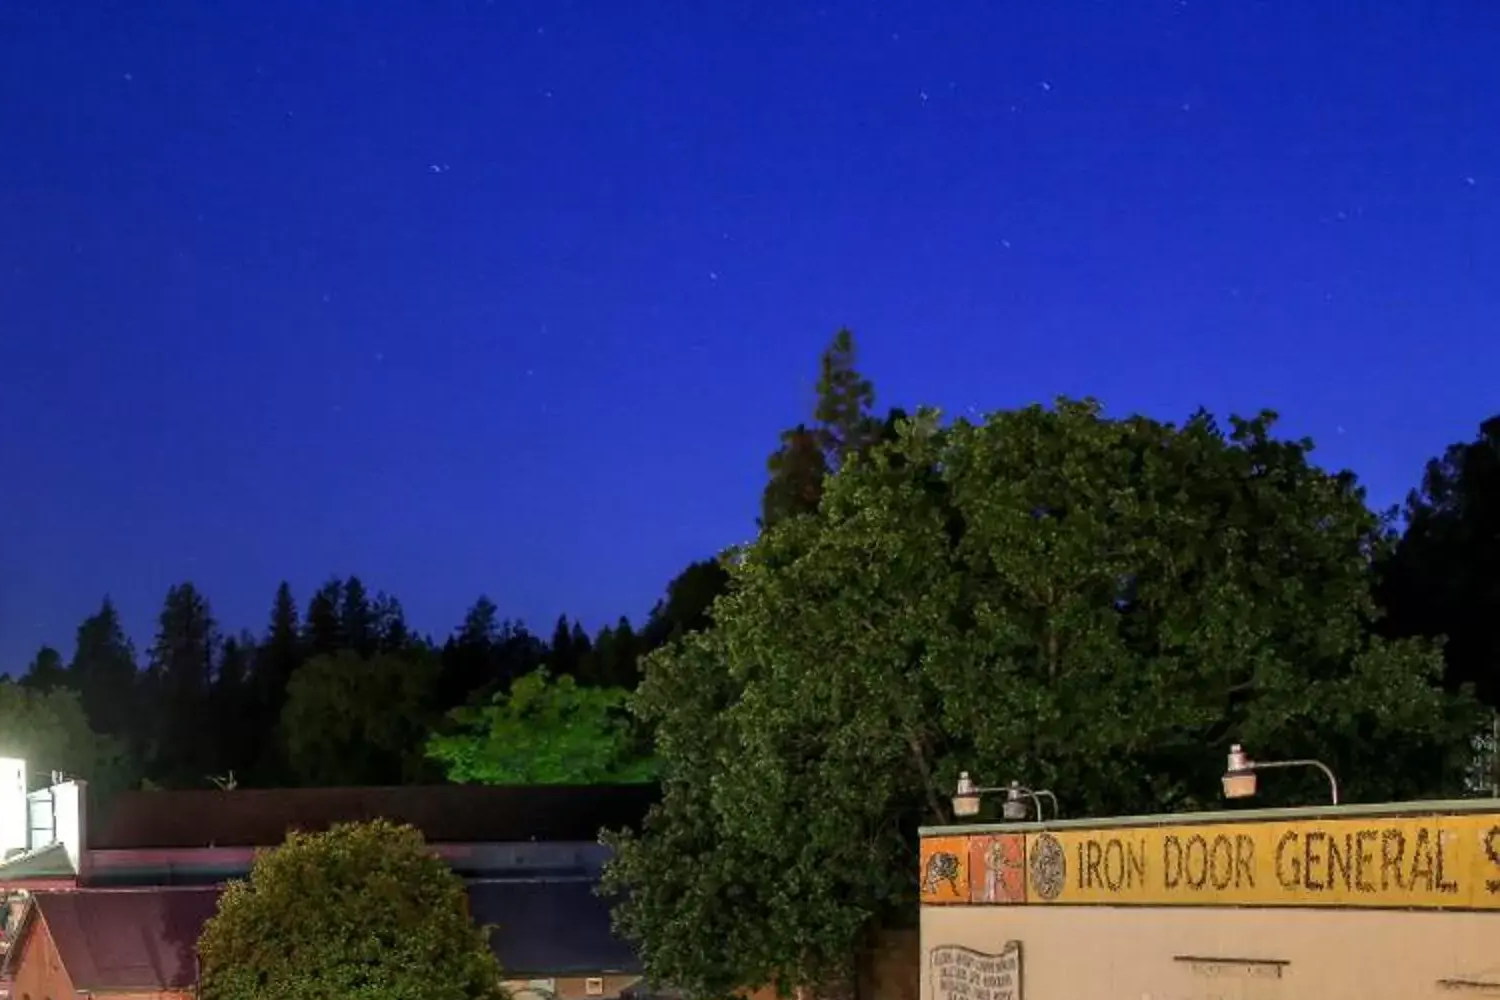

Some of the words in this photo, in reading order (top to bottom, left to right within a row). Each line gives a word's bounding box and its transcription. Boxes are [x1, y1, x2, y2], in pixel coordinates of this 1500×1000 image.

[1077, 837, 1146, 892] IRON
[1163, 833, 1255, 892] DOOR
[1275, 827, 1460, 894] GENERAL
